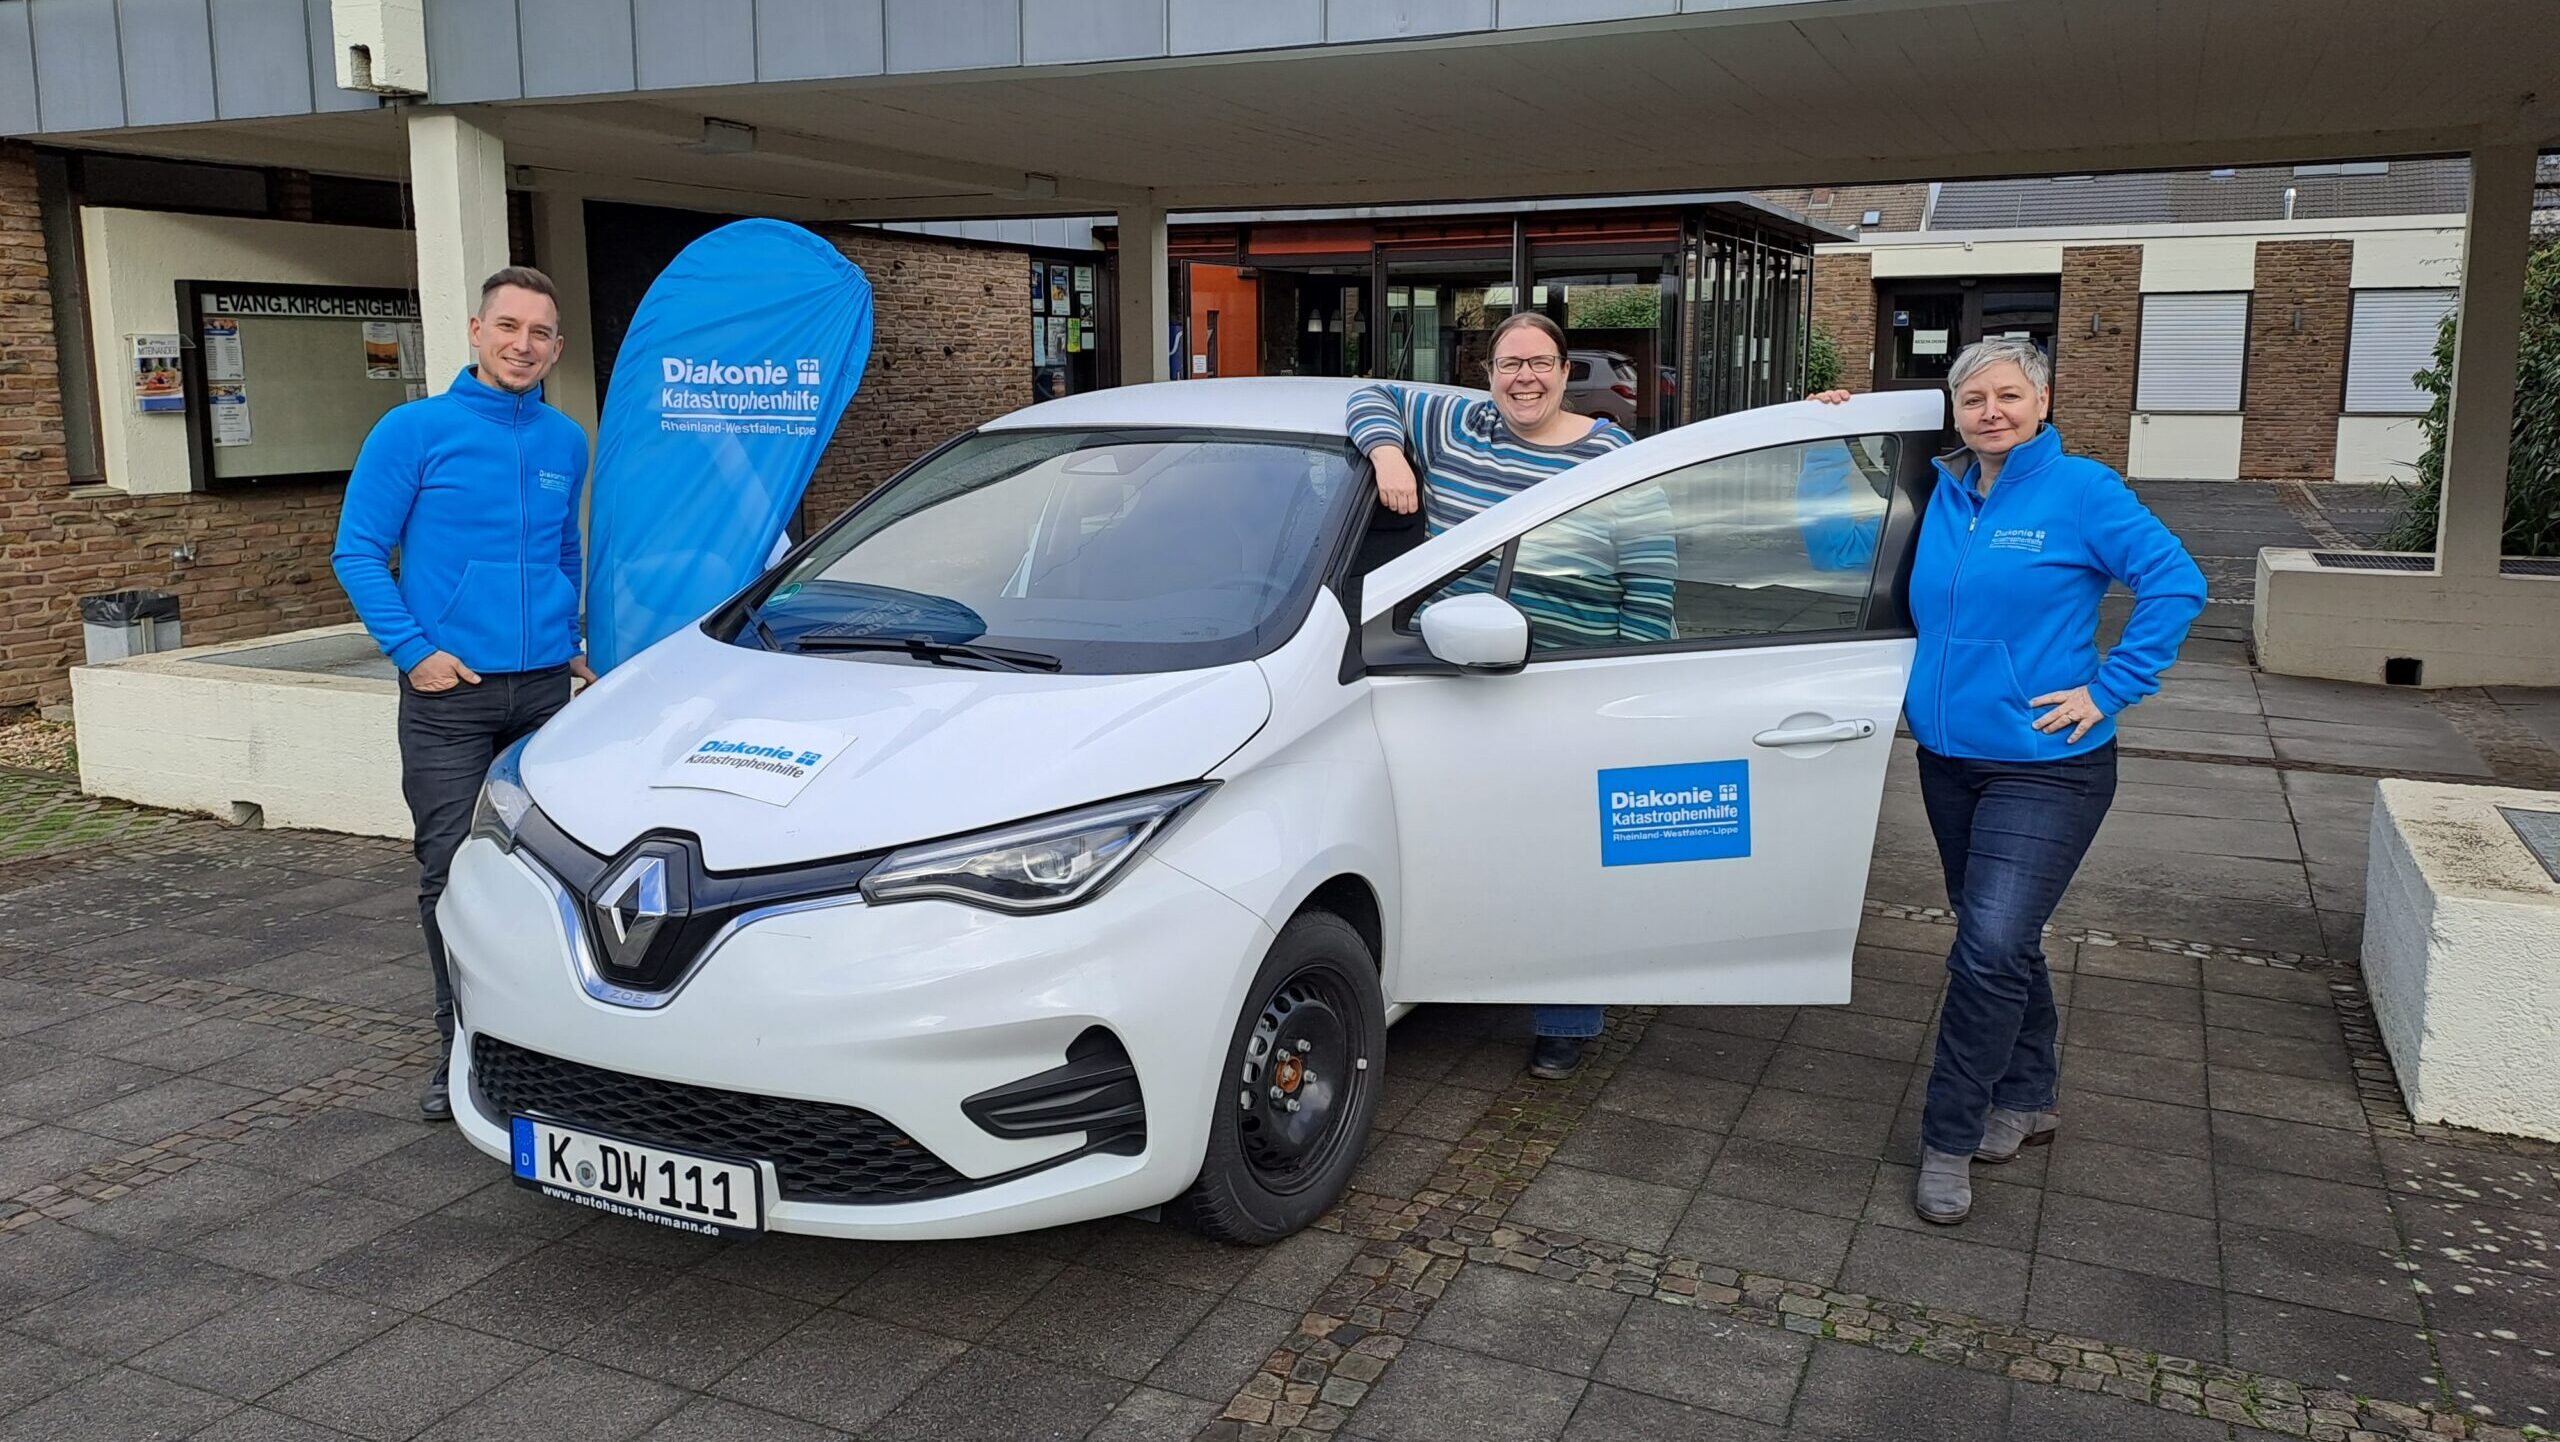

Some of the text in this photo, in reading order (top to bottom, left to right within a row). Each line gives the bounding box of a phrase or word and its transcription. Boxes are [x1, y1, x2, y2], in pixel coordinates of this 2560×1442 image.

[661, 356, 788, 385] Diakonie
[661, 387, 820, 414] Katastrophenhilfe
[660, 420, 817, 438] Rheinland-Westfalen-Lippe
[698, 740, 794, 761] Diakonie
[684, 753, 805, 779] Katastrophenhilfe
[1611, 786, 1713, 810] Diakonie
[1612, 805, 1739, 826] Katastrophenhilfe
[1612, 826, 1739, 843] Rheinland-Westfalen-Lippe
[521, 1153, 530, 1167] D
[548, 1132, 738, 1220] K DW 111
[541, 1184, 720, 1237] www.autohaus-hermann.de
